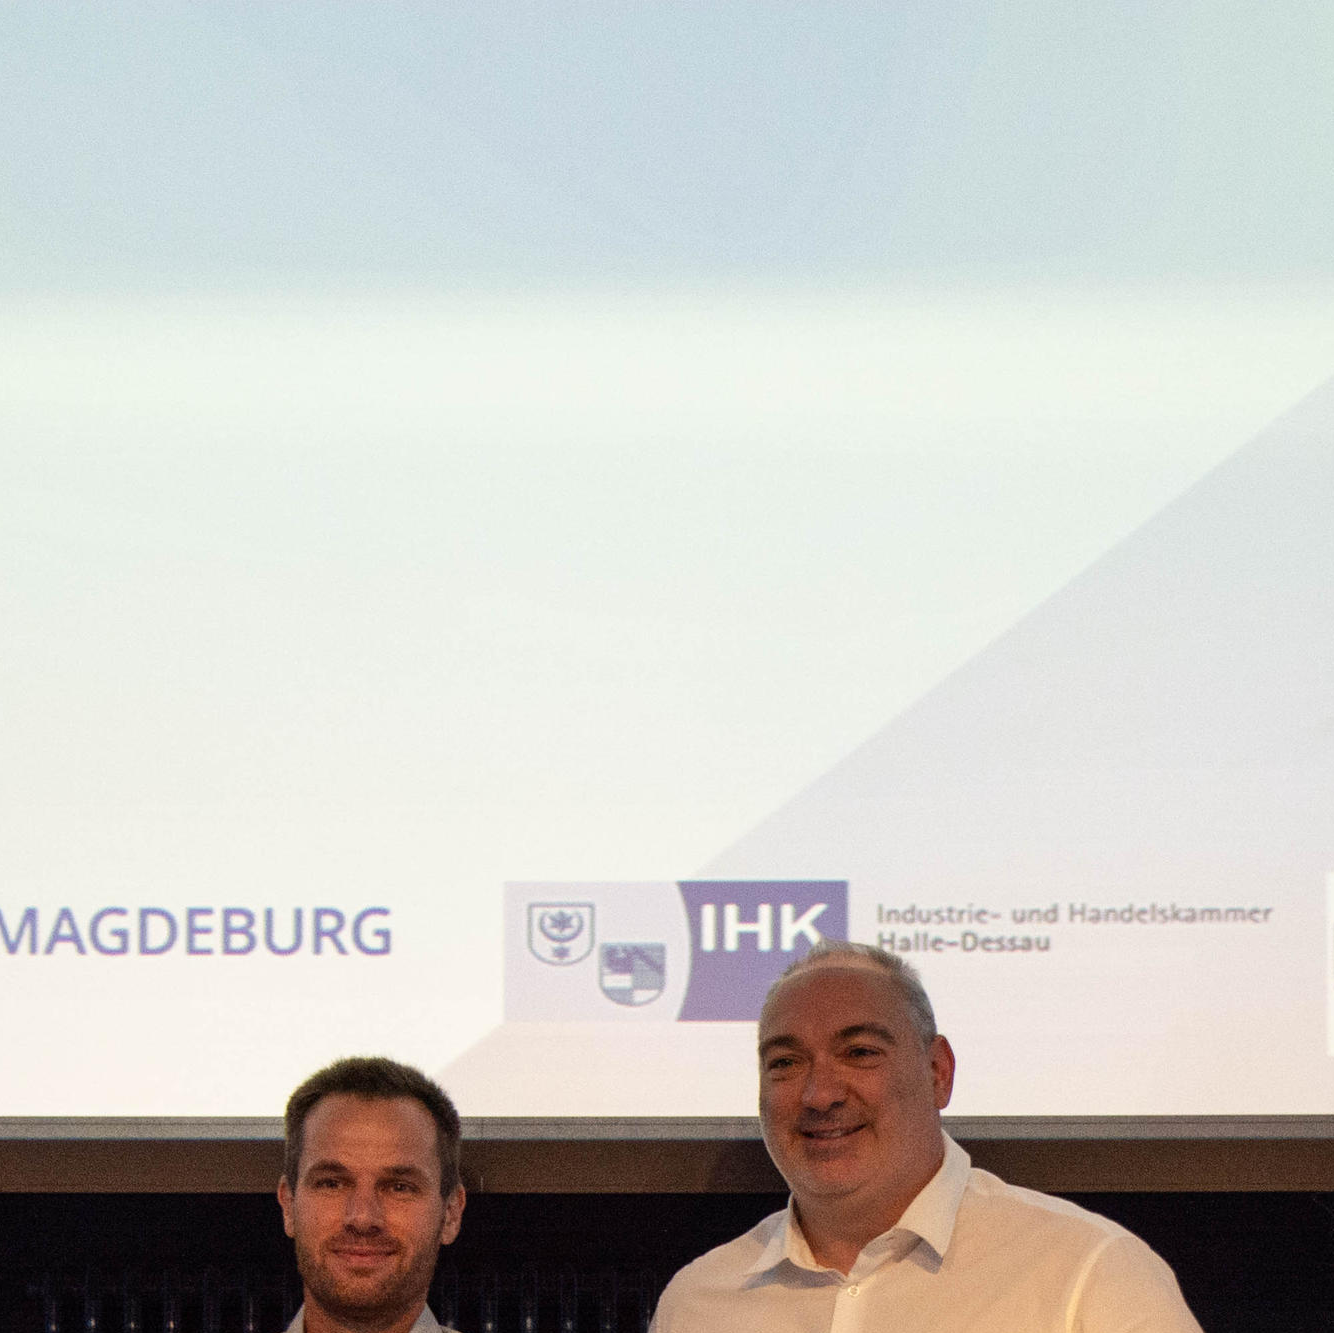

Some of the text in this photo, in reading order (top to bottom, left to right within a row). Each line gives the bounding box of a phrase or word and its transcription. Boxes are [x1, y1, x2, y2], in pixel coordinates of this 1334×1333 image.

[701, 900, 1273, 952] IHK Industrie- und Handelskammer
[876, 931, 1051, 954] Halle-Dessau
